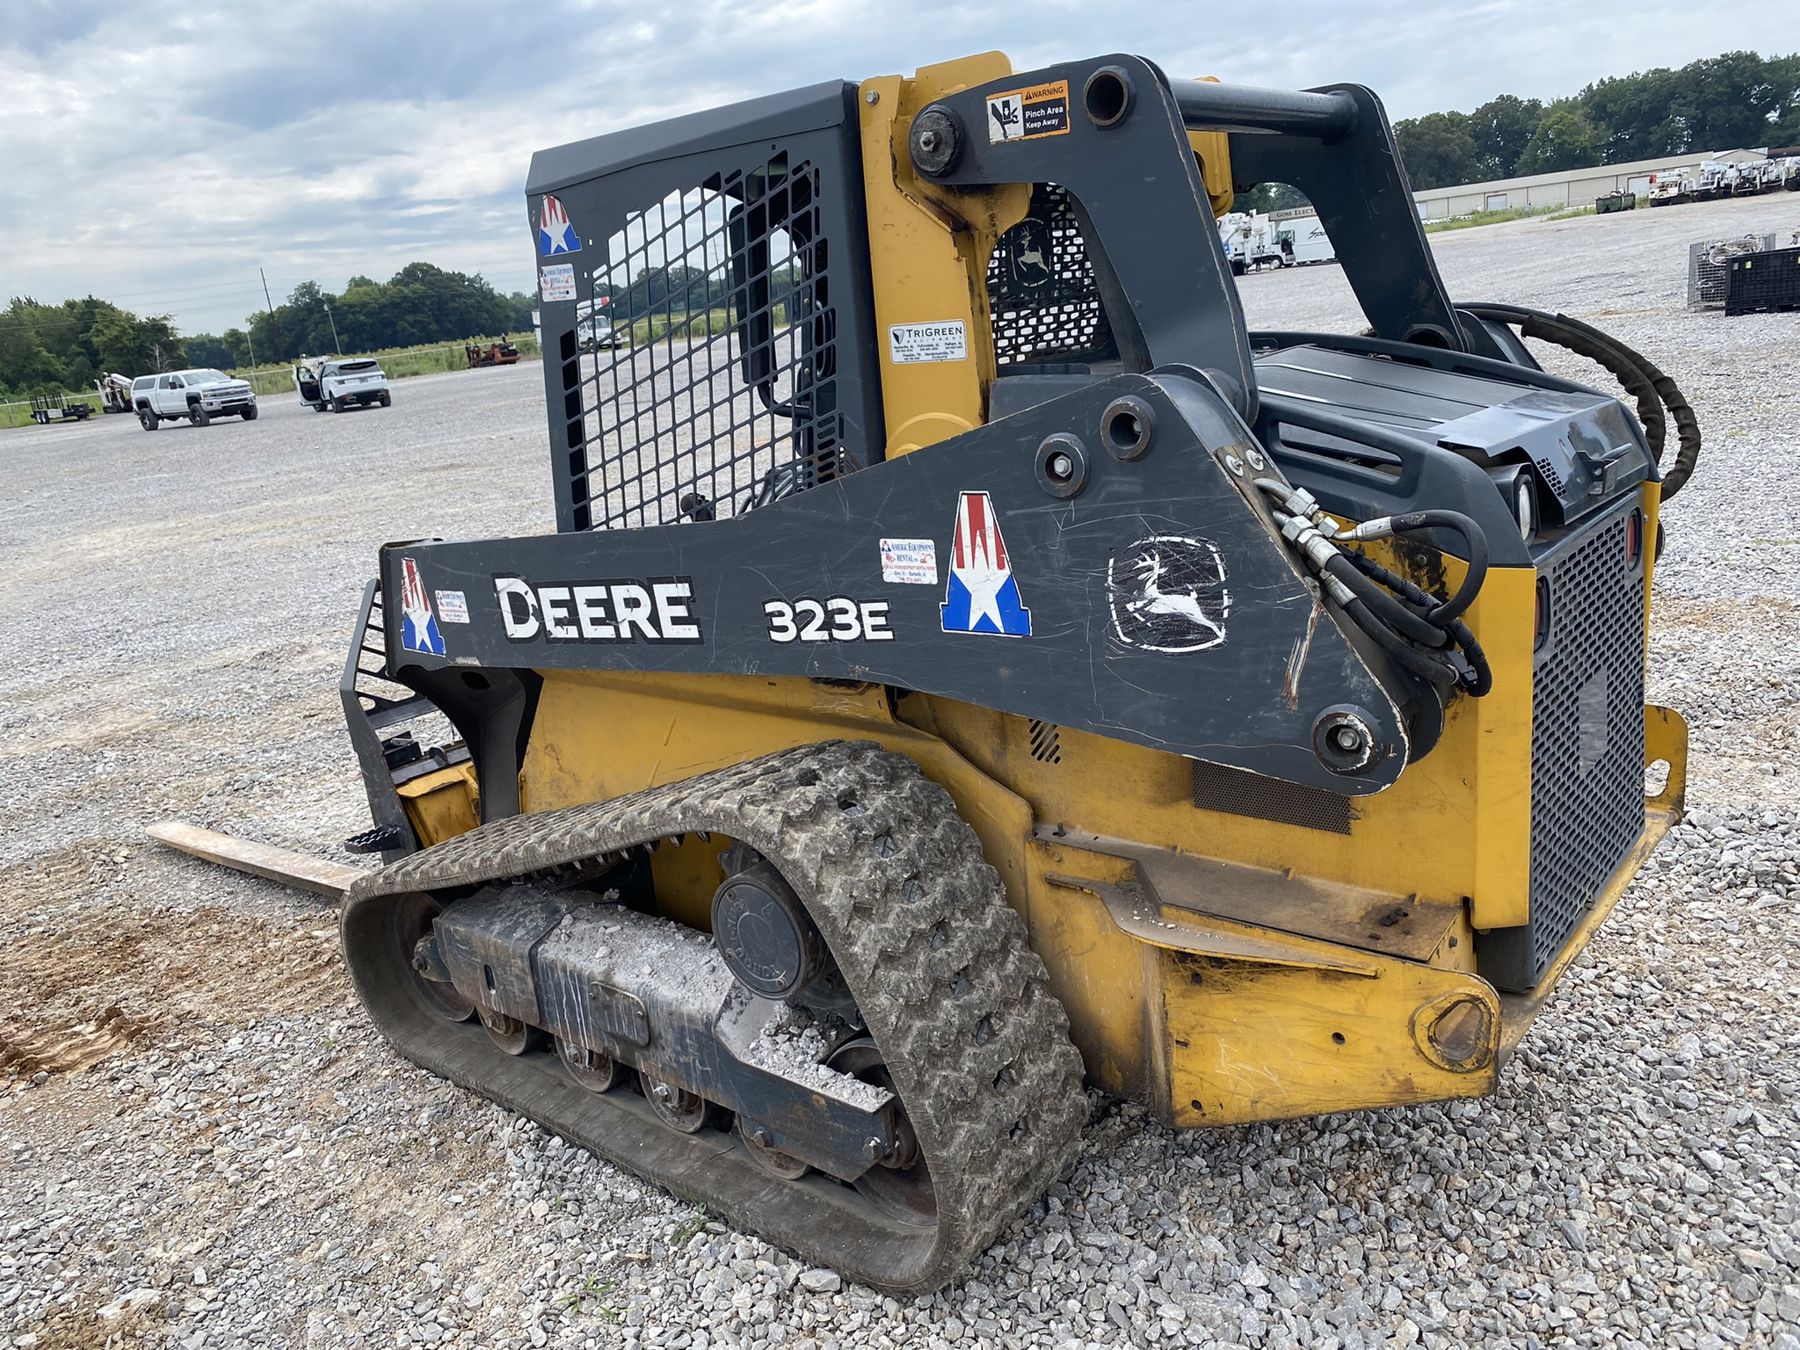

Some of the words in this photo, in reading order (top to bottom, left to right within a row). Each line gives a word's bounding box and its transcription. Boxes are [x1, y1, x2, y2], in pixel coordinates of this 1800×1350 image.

[1031, 87, 1063, 98] WARNING
[1025, 108, 1046, 119] Pinch
[1046, 105, 1064, 115] Area
[1026, 121, 1041, 130] Keep
[1042, 118, 1059, 127] Away
[906, 326, 962, 338] TRIGREEN
[494, 578, 700, 638] DEERE
[764, 598, 894, 642] 323E
